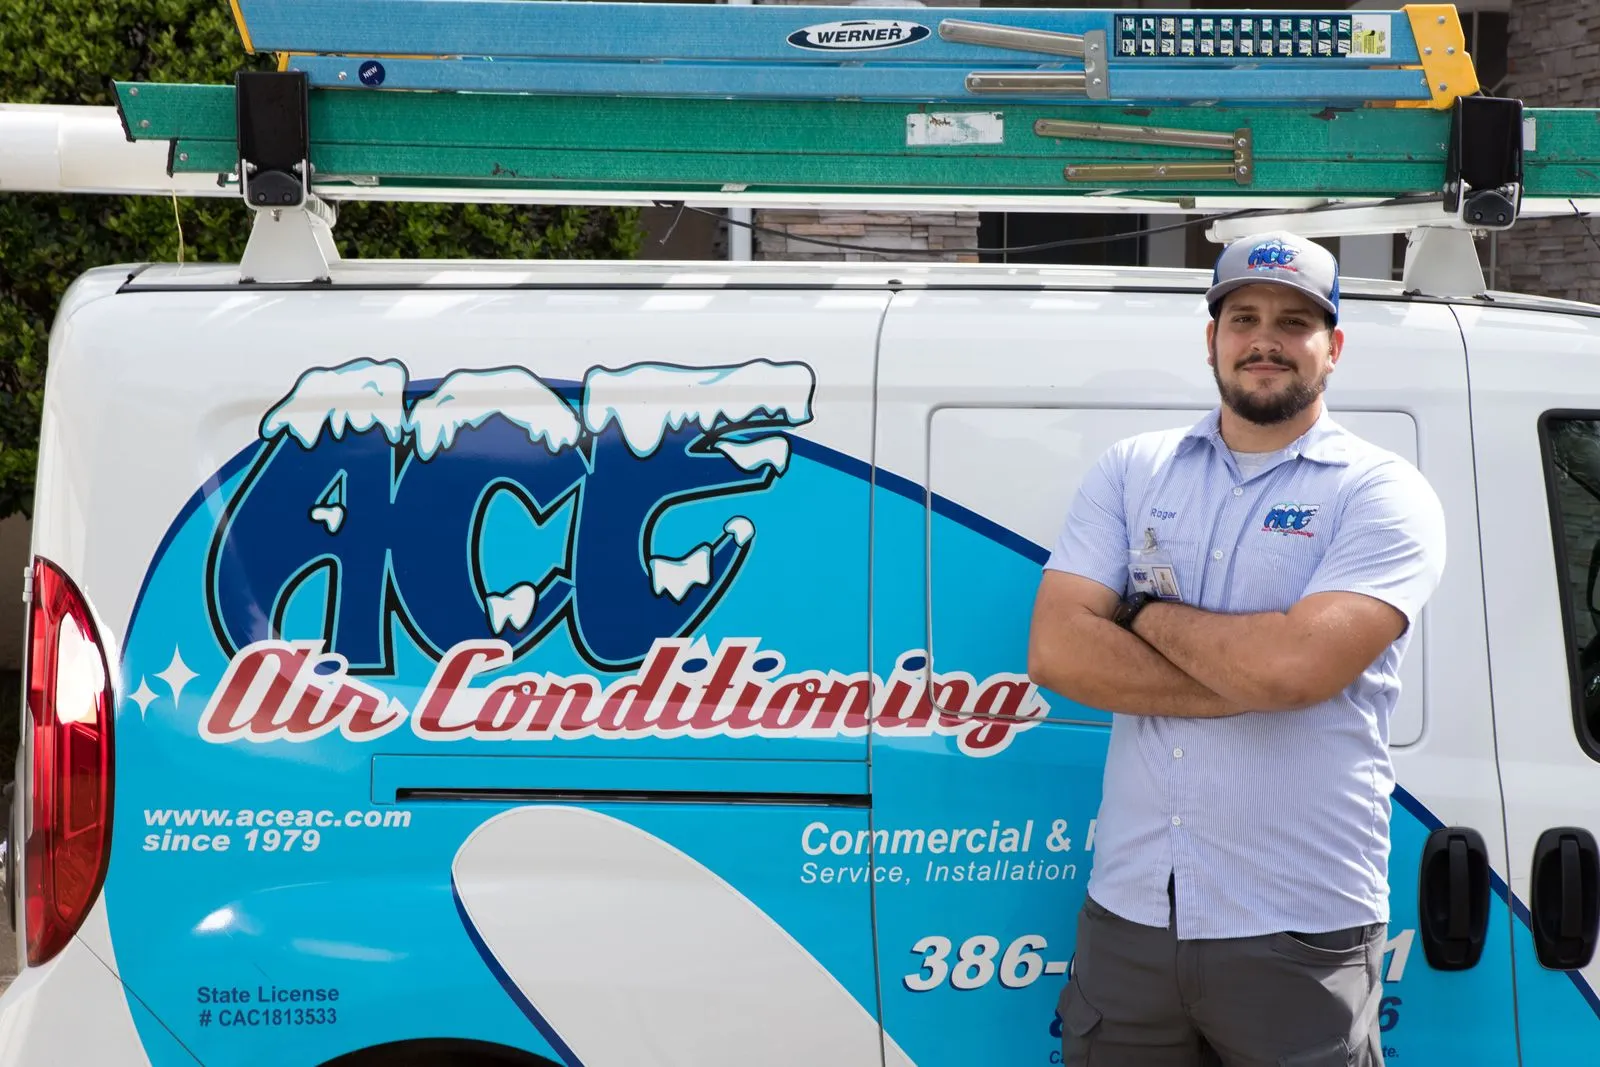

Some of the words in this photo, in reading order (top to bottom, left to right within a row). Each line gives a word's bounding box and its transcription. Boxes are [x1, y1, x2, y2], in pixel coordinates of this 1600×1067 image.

[817, 28, 902, 44] WERNER
[362, 65, 378, 79] NEW
[207, 358, 816, 675] ACE
[1151, 507, 1176, 521] Roger
[1264, 503, 1320, 530] ACE
[200, 641, 406, 741] Air
[412, 637, 1050, 757] Conditioning
[143, 809, 412, 828] www.aceac.com
[142, 829, 231, 852] since
[243, 829, 321, 852] 1979
[801, 819, 1034, 856] Commercial
[1045, 818, 1072, 852] &
[800, 861, 912, 885] Service,
[925, 859, 1077, 882] Installation
[903, 934, 1077, 992] 386-
[197, 987, 250, 1004] State
[257, 986, 340, 1003] License
[198, 1010, 213, 1027] #
[218, 1008, 337, 1027] CAC1813533
